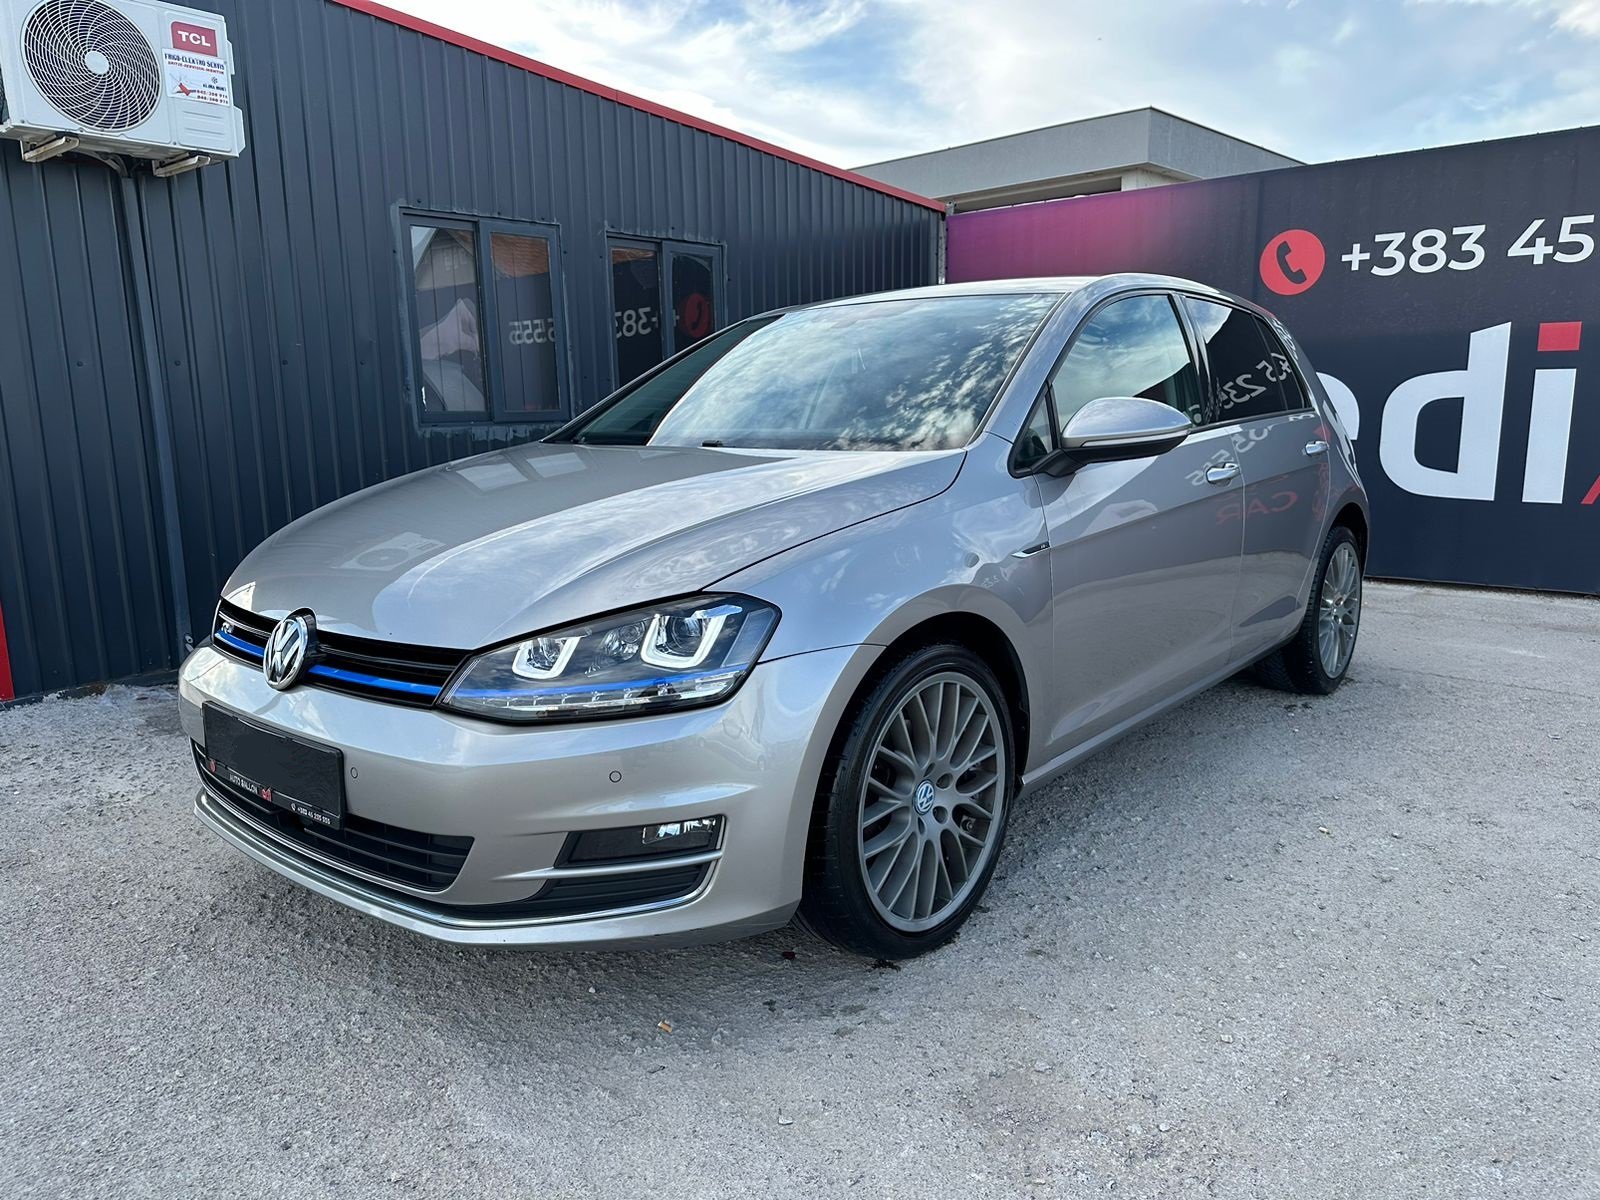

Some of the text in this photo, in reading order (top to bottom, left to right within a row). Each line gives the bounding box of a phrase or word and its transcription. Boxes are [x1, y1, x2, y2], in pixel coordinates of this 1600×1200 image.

[177, 30, 211, 47] TCL
[1340, 213, 1596, 277] +383 45
